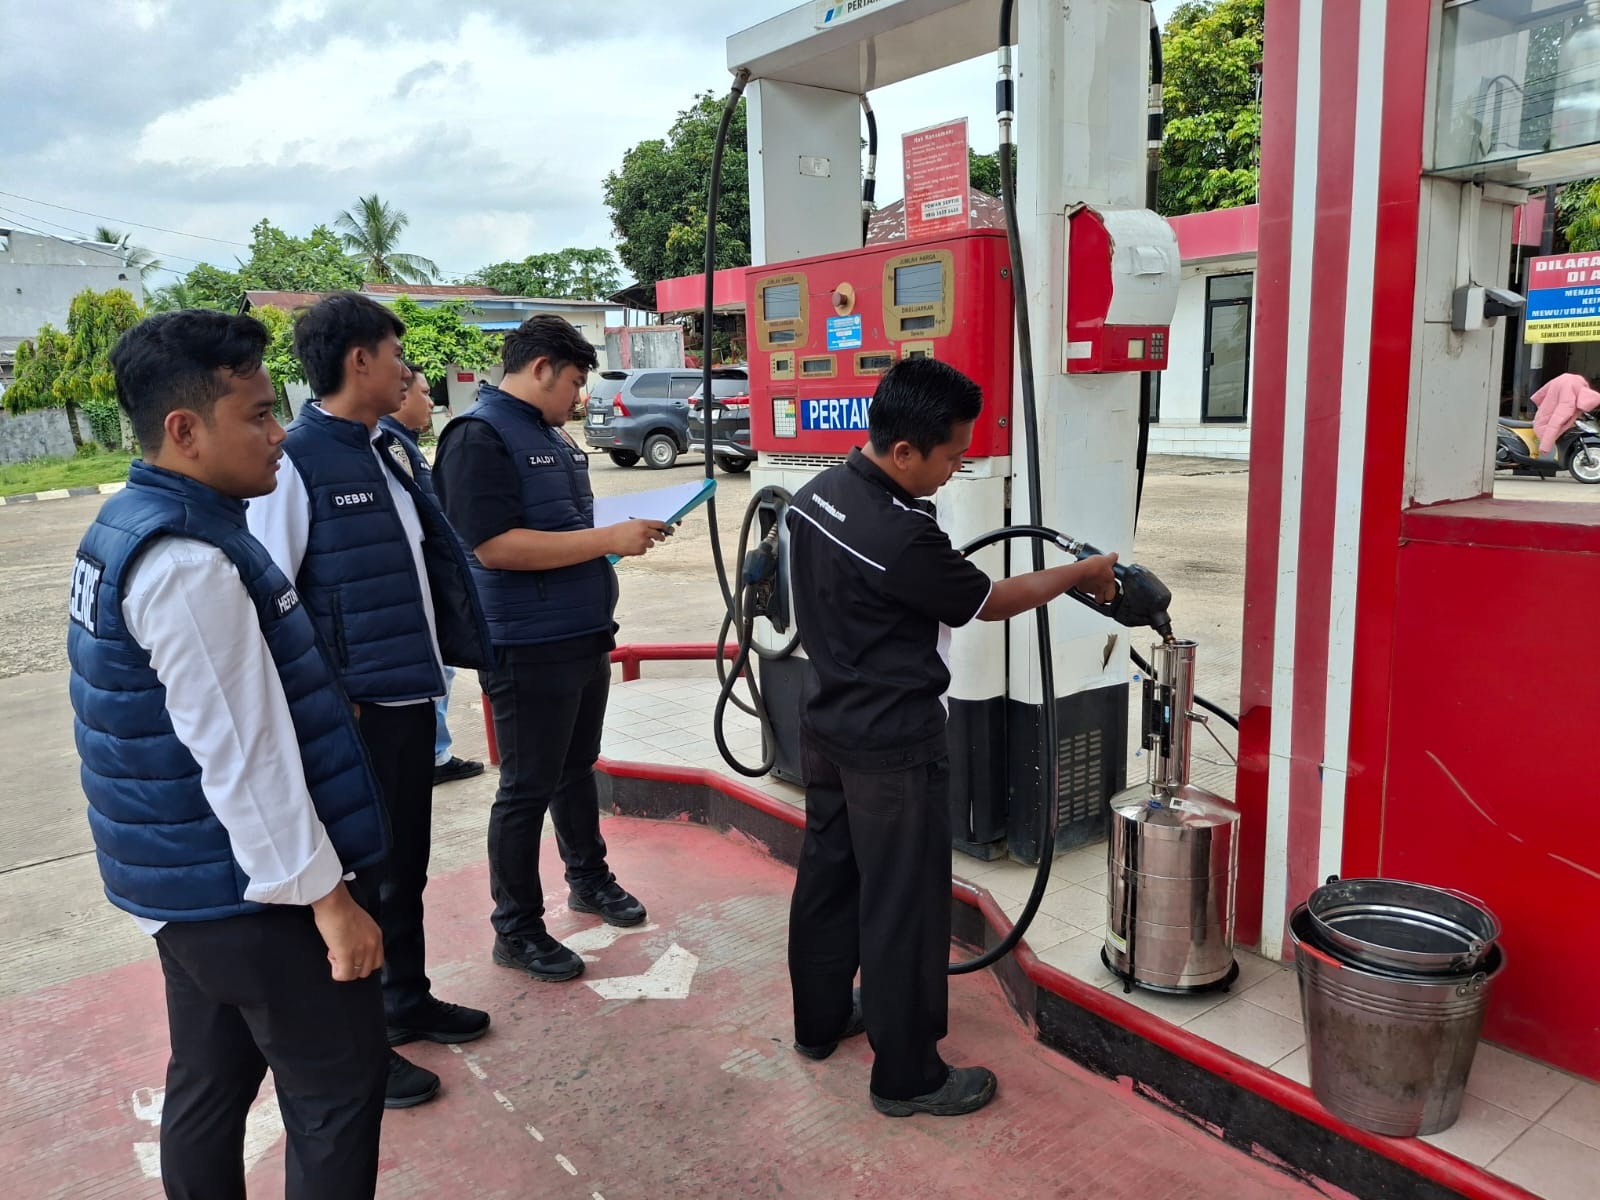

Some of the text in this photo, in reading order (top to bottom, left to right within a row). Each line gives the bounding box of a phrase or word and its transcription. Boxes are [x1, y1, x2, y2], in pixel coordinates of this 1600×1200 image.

[1535, 256, 1600, 272] DILARA
[1567, 271, 1586, 283] DI
[529, 455, 555, 465] ZALDY
[334, 492, 374, 505] DEBBY
